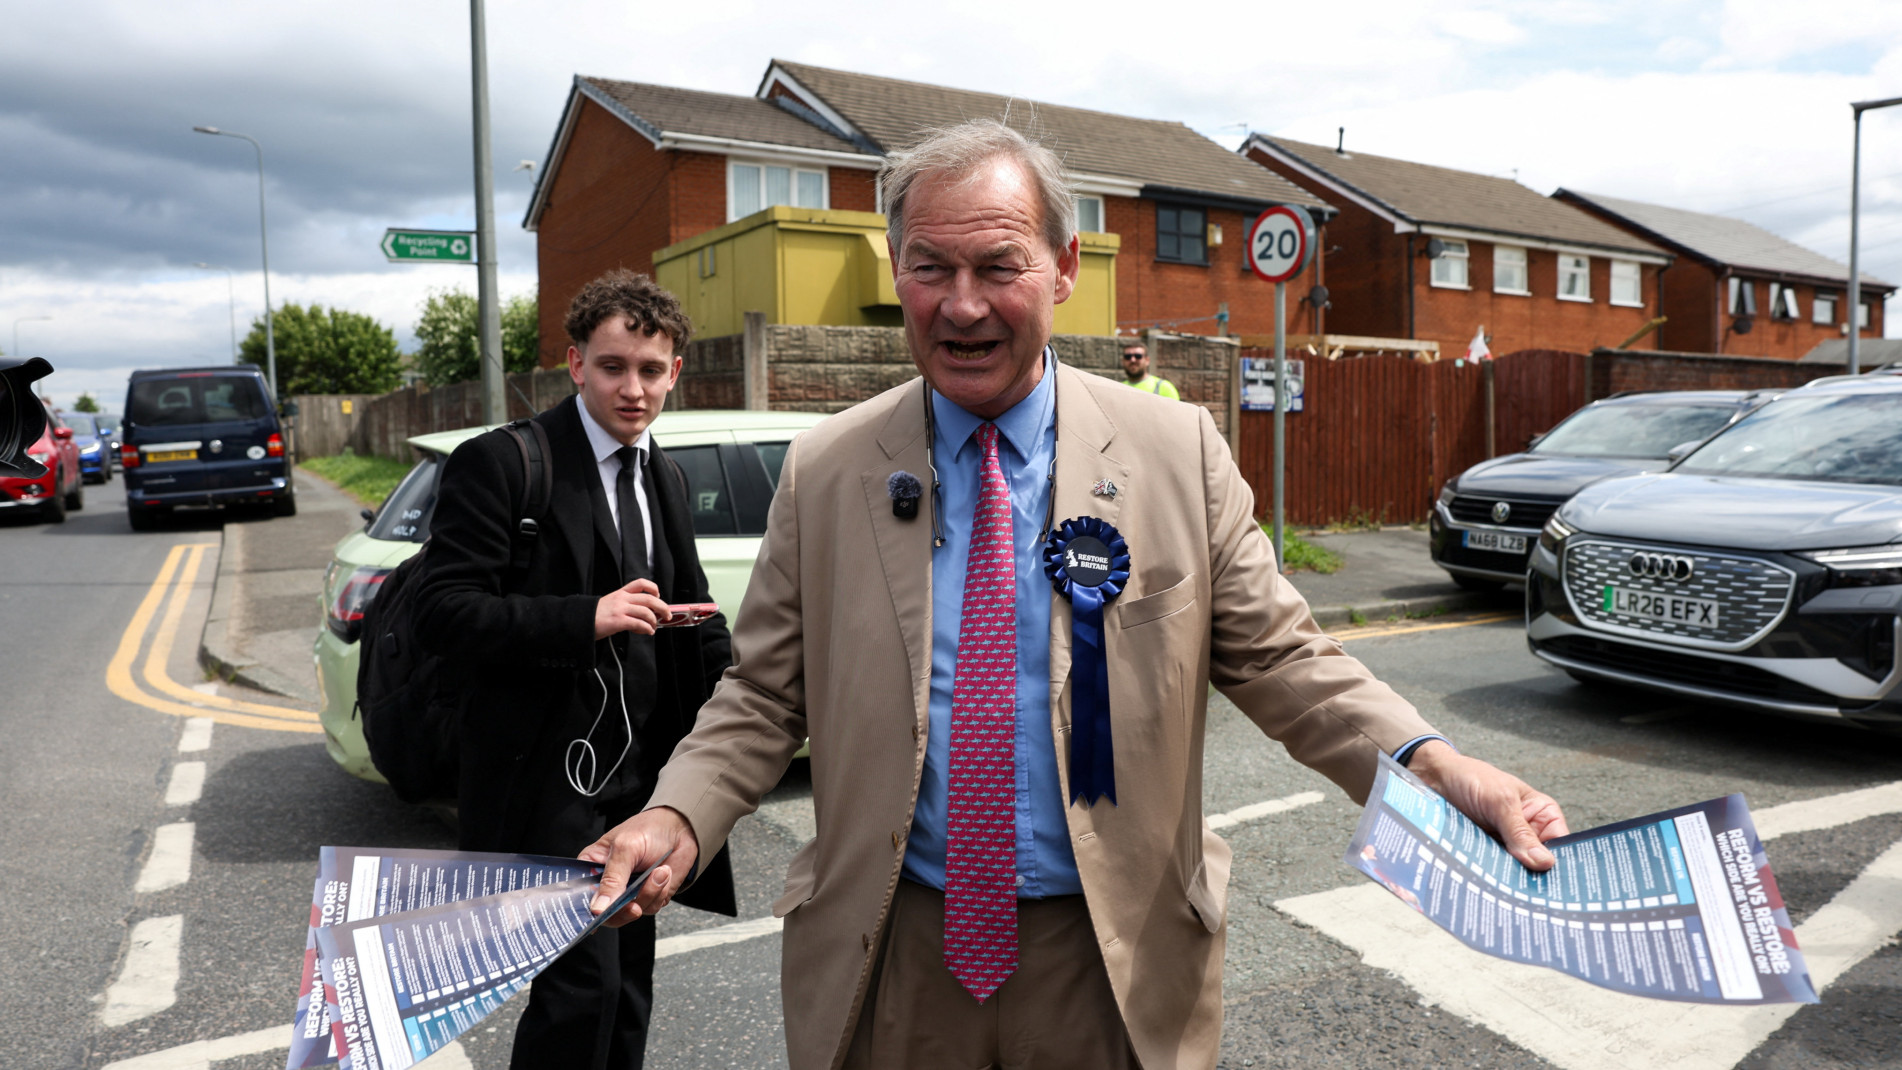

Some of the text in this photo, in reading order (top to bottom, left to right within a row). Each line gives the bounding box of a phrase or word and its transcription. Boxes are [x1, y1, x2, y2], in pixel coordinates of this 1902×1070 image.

[398, 235, 448, 248] Recycling
[410, 247, 438, 257] Point
[1257, 229, 1297, 260] 20
[1078, 553, 1108, 564] RESTORE
[1080, 561, 1108, 571] BRITAIN
[1615, 591, 1712, 624] LR26 EFX
[1716, 832, 1734, 863] WHICH
[1725, 862, 1742, 883] SIDE
[338, 881, 348, 902] ON?
[1728, 828, 1791, 975] REFORM VS RESTORE:
[1732, 884, 1747, 902] ARE
[1738, 902, 1754, 922] YOU
[1744, 921, 1765, 954] REALLY
[387, 942, 404, 994] RESTORE BRITAIN
[332, 957, 356, 1024] RESTORE:
[350, 976, 364, 1008] REALLY
[304, 979, 325, 1038] REFORM
[356, 1009, 368, 1027] YOU
[344, 1024, 360, 1043] VS
